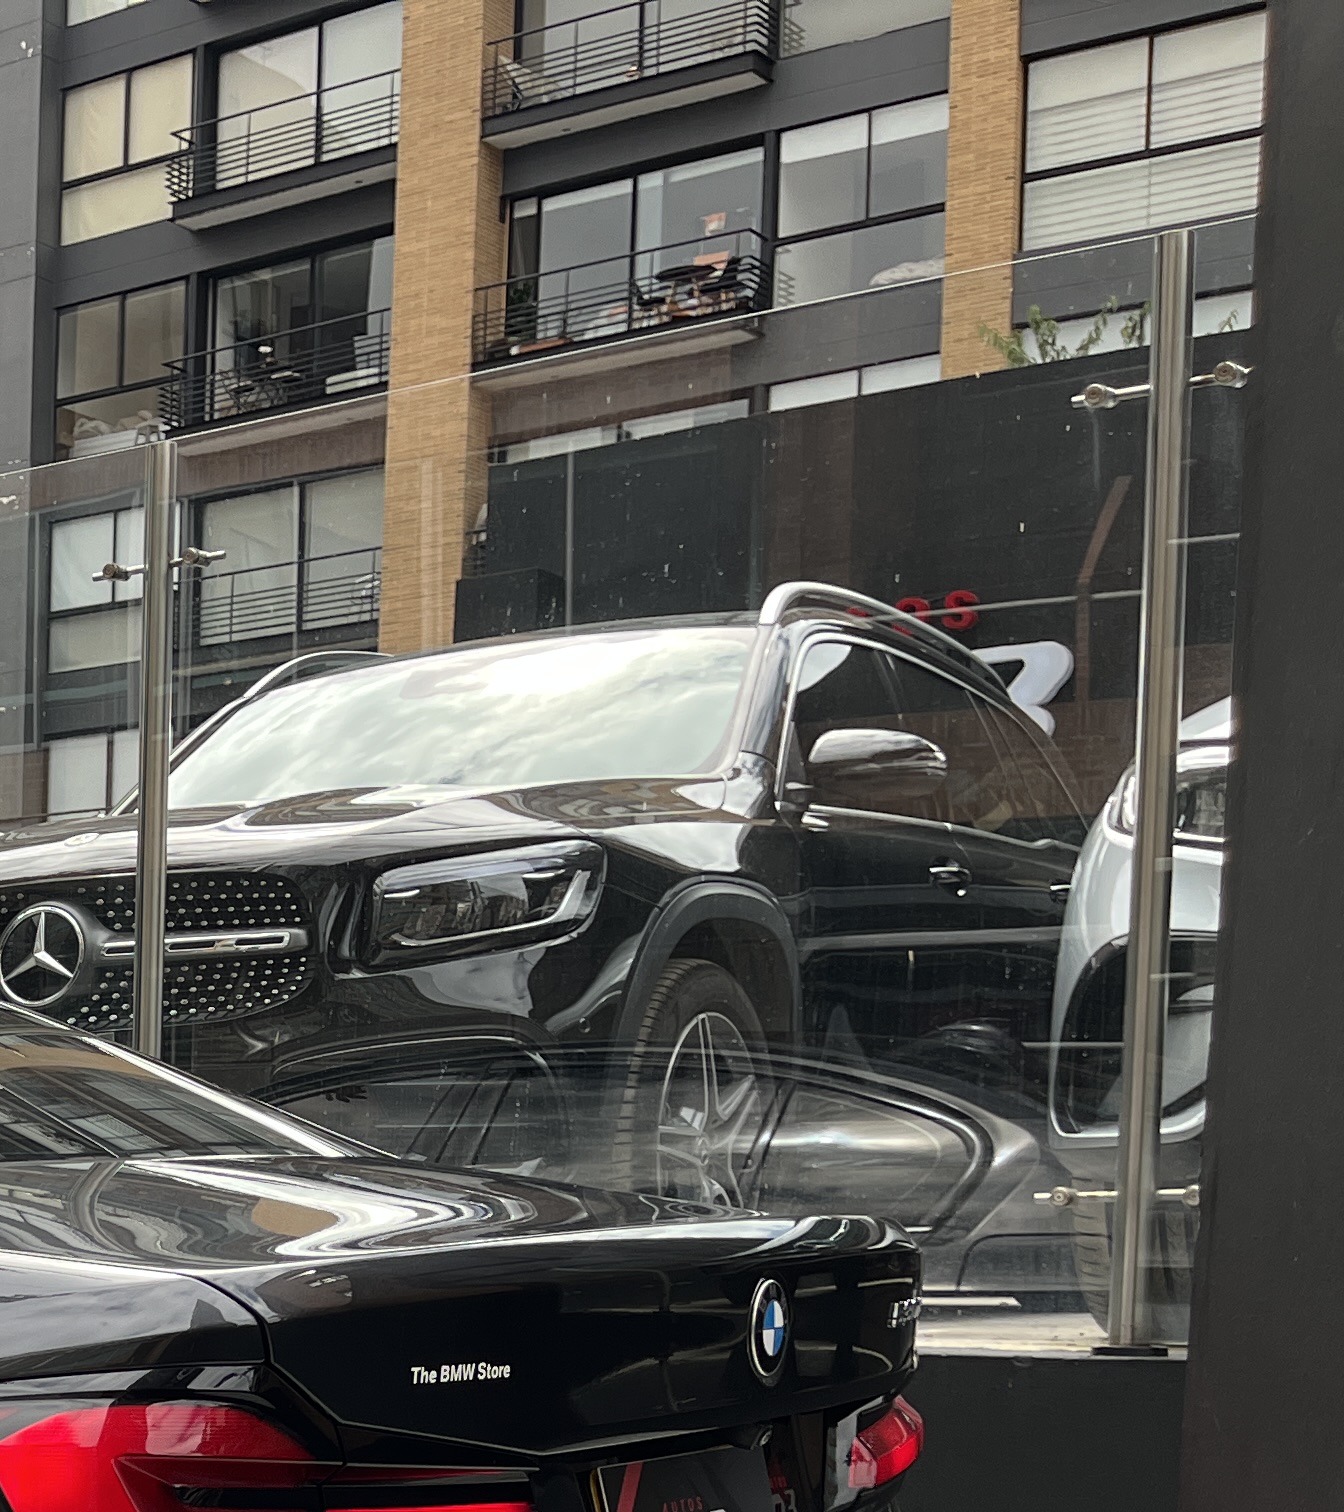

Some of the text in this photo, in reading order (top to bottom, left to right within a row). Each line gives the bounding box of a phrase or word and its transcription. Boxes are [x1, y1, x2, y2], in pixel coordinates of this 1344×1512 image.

[411, 1362, 511, 1385] The BMW Store
